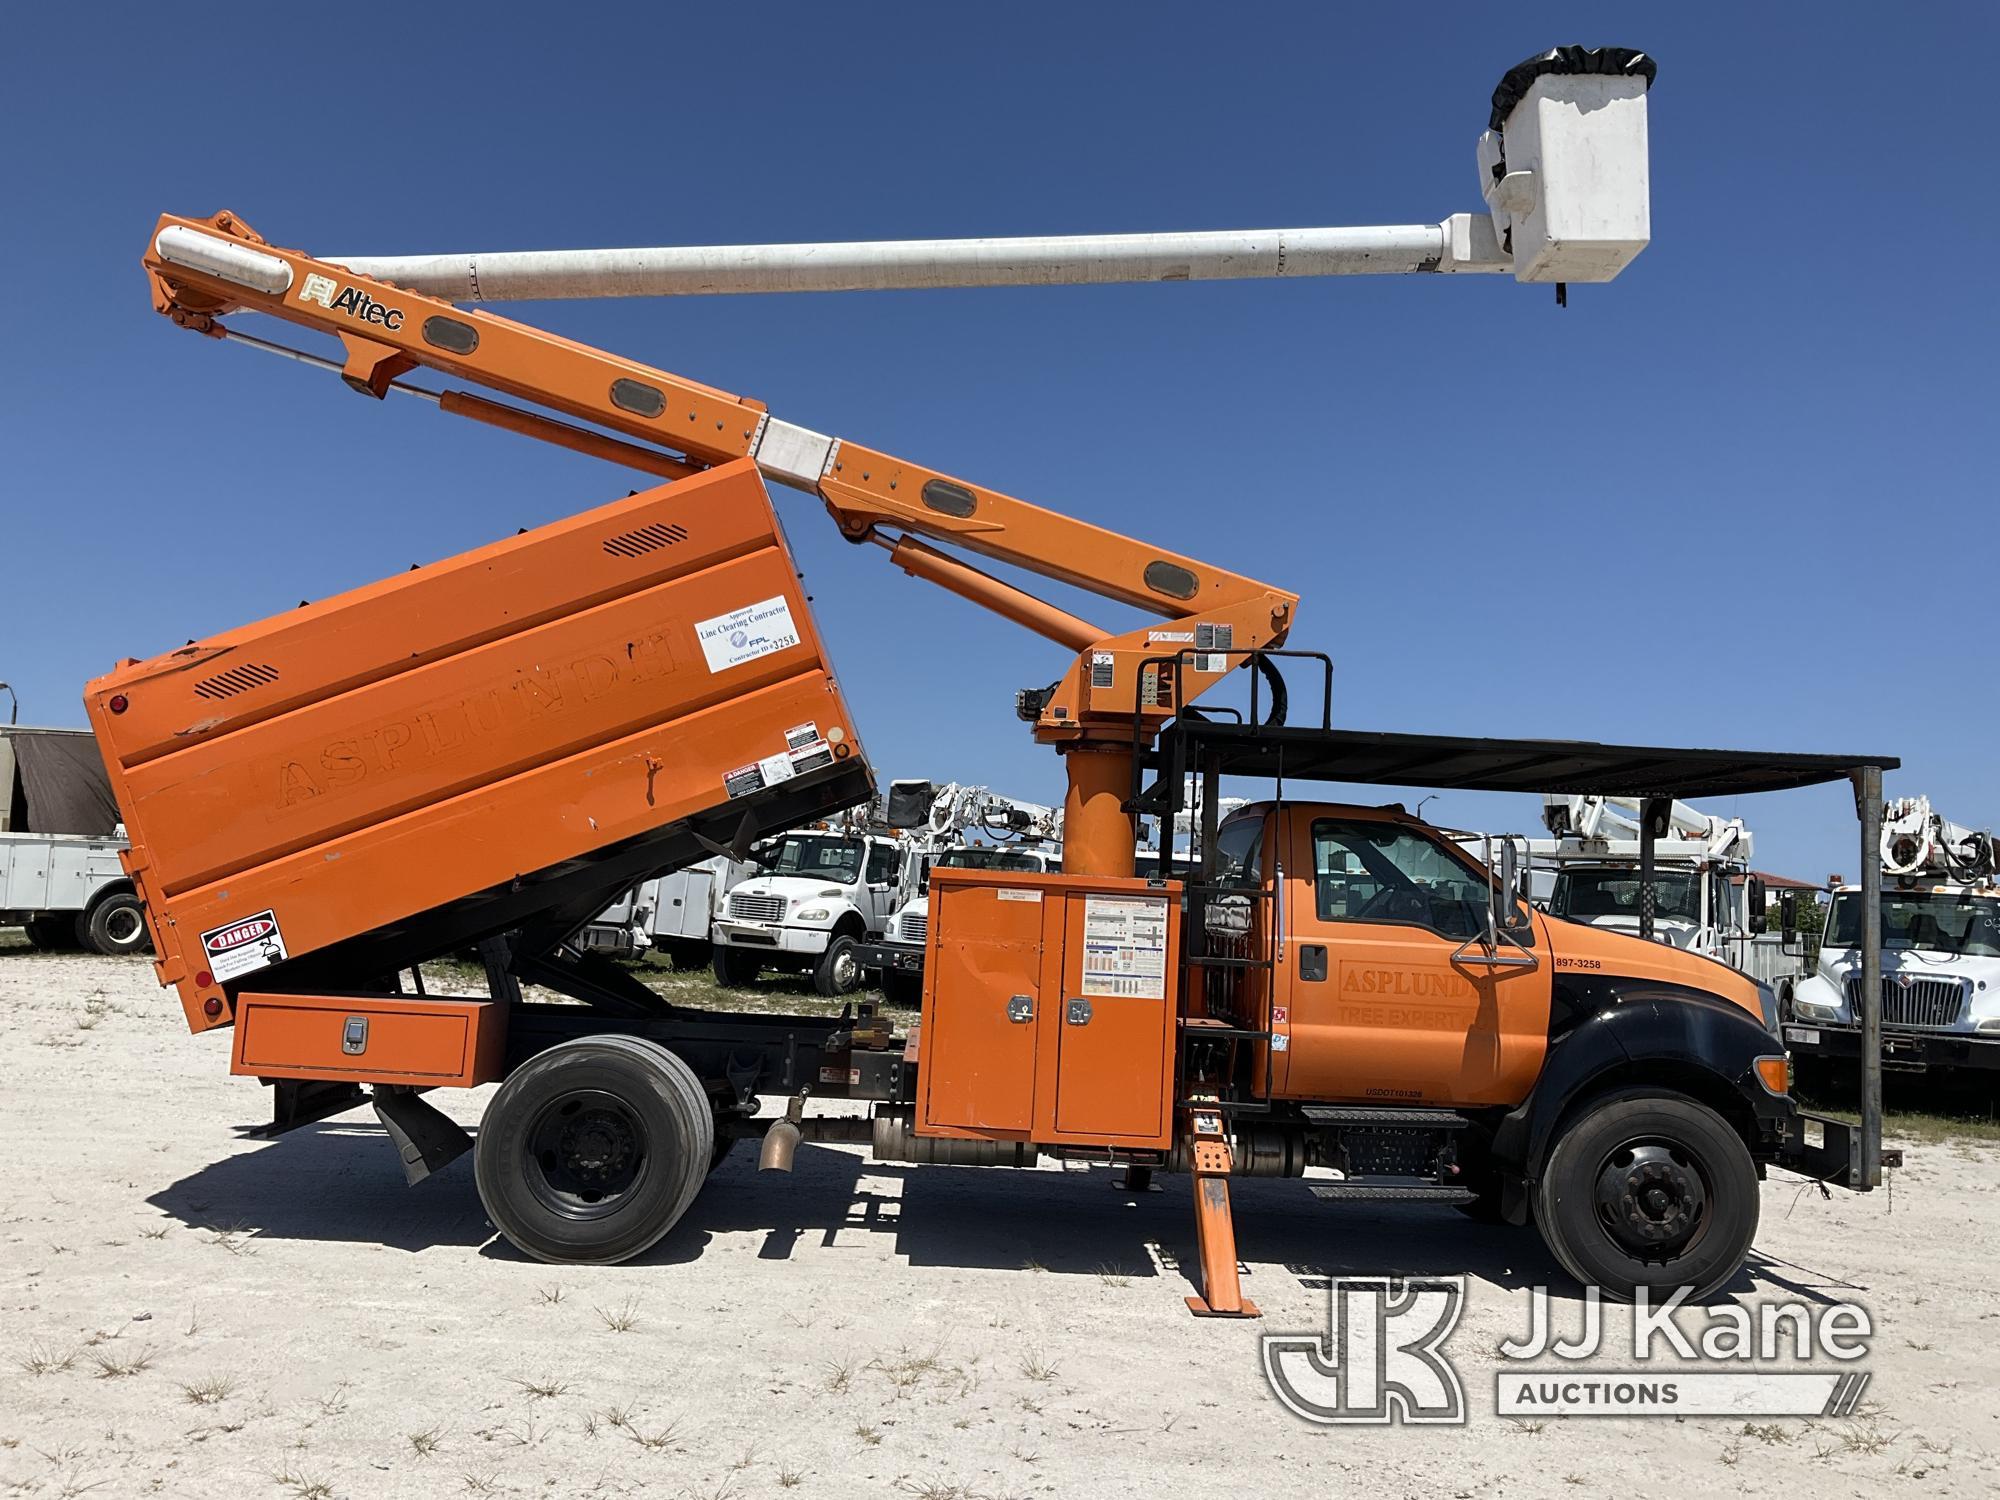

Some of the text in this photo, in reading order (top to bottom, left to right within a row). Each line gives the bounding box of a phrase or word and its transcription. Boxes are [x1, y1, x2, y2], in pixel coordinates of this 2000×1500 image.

[330, 286, 404, 331] Altec
[700, 606, 786, 640] Line Clearing Contractor
[730, 608, 753, 620] Approved
[749, 635, 771, 648] FPL
[729, 649, 760, 663] Contractor
[277, 627, 682, 809] ASPLUNDH
[733, 764, 757, 777] DANGER
[219, 923, 263, 947] DANGER
[1556, 958, 1601, 969] 897-3258
[1337, 1006, 1383, 1025] TREE
[1389, 1009, 1461, 1029] EXPERT
